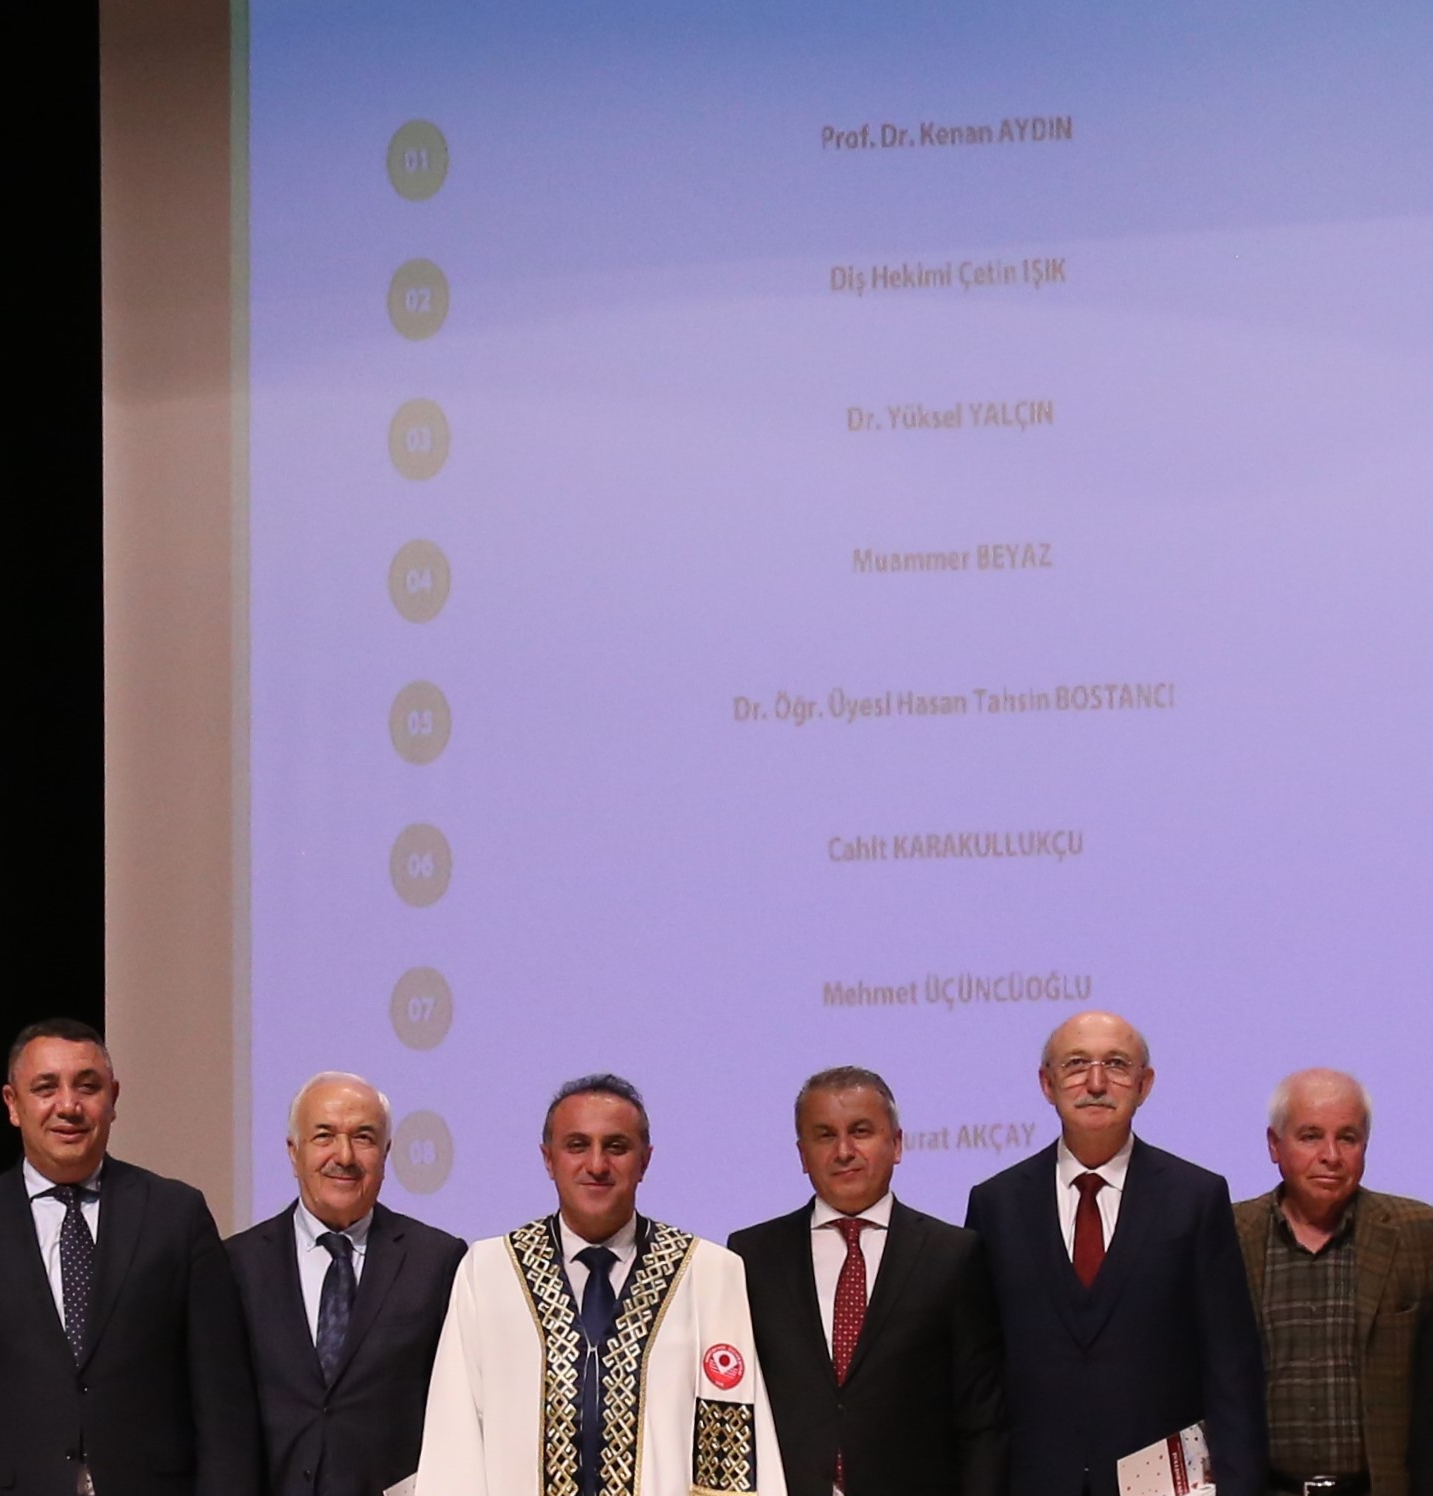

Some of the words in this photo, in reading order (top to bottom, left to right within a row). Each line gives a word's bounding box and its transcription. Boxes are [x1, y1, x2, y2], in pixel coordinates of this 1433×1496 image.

[821, 124, 875, 150] Prof.
[880, 123, 915, 148] Dr.
[919, 122, 993, 147] Kenan
[997, 115, 1073, 142] AYDIN
[829, 266, 866, 296] Diş
[870, 262, 952, 291] Hekimi
[958, 260, 1017, 293] Çetin
[1022, 256, 1067, 289] IŞIK
[846, 406, 882, 432] Dr.
[886, 400, 964, 430] Yüksel
[968, 398, 1055, 432] YALÇIN
[851, 546, 969, 574] Muammer
[976, 542, 1053, 571] BEYAZ
[732, 695, 767, 721] Dr.
[774, 690, 823, 727] Öğr.
[827, 687, 891, 724] Üyesi
[896, 690, 967, 717] Hasan
[972, 687, 1051, 715] Tahsin
[1053, 682, 1176, 710] BOSTANCI
[827, 835, 887, 862] Cahit
[892, 830, 1085, 863] KARAKULLUKÇU
[822, 981, 918, 1006] Mehmet
[901, 1126, 949, 1151] urat
[957, 1121, 1035, 1153] AKÇAY
